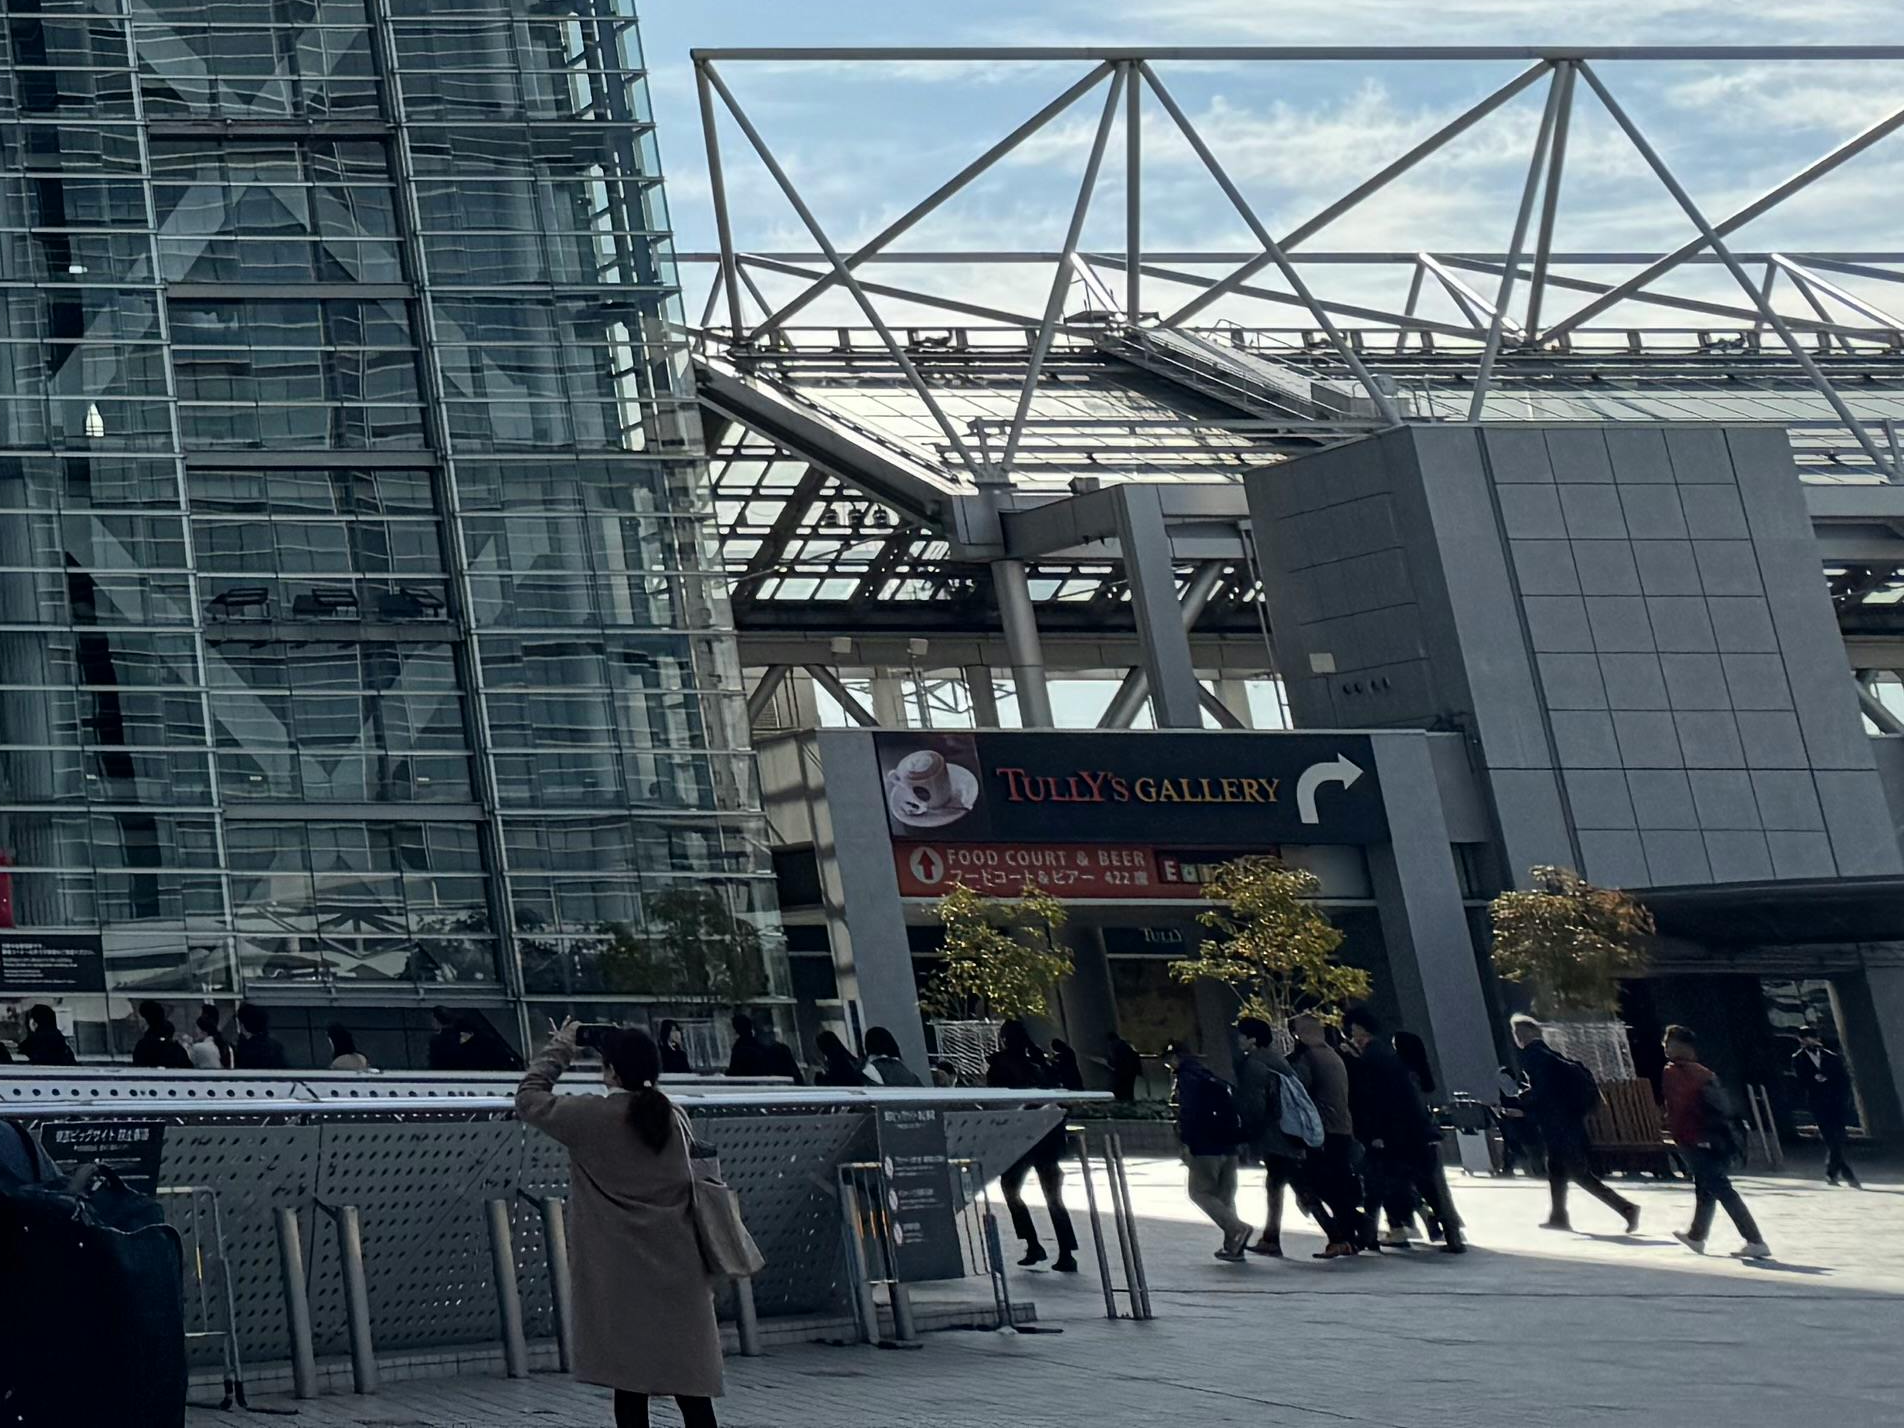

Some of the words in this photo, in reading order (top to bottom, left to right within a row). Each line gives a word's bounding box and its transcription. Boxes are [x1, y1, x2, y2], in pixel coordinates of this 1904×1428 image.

[1135, 777, 1281, 803] GALLERY
[946, 849, 998, 865] FOOD
[1005, 850, 1068, 866] COURT
[1076, 851, 1089, 866] &
[1097, 850, 1145, 866] BEER
